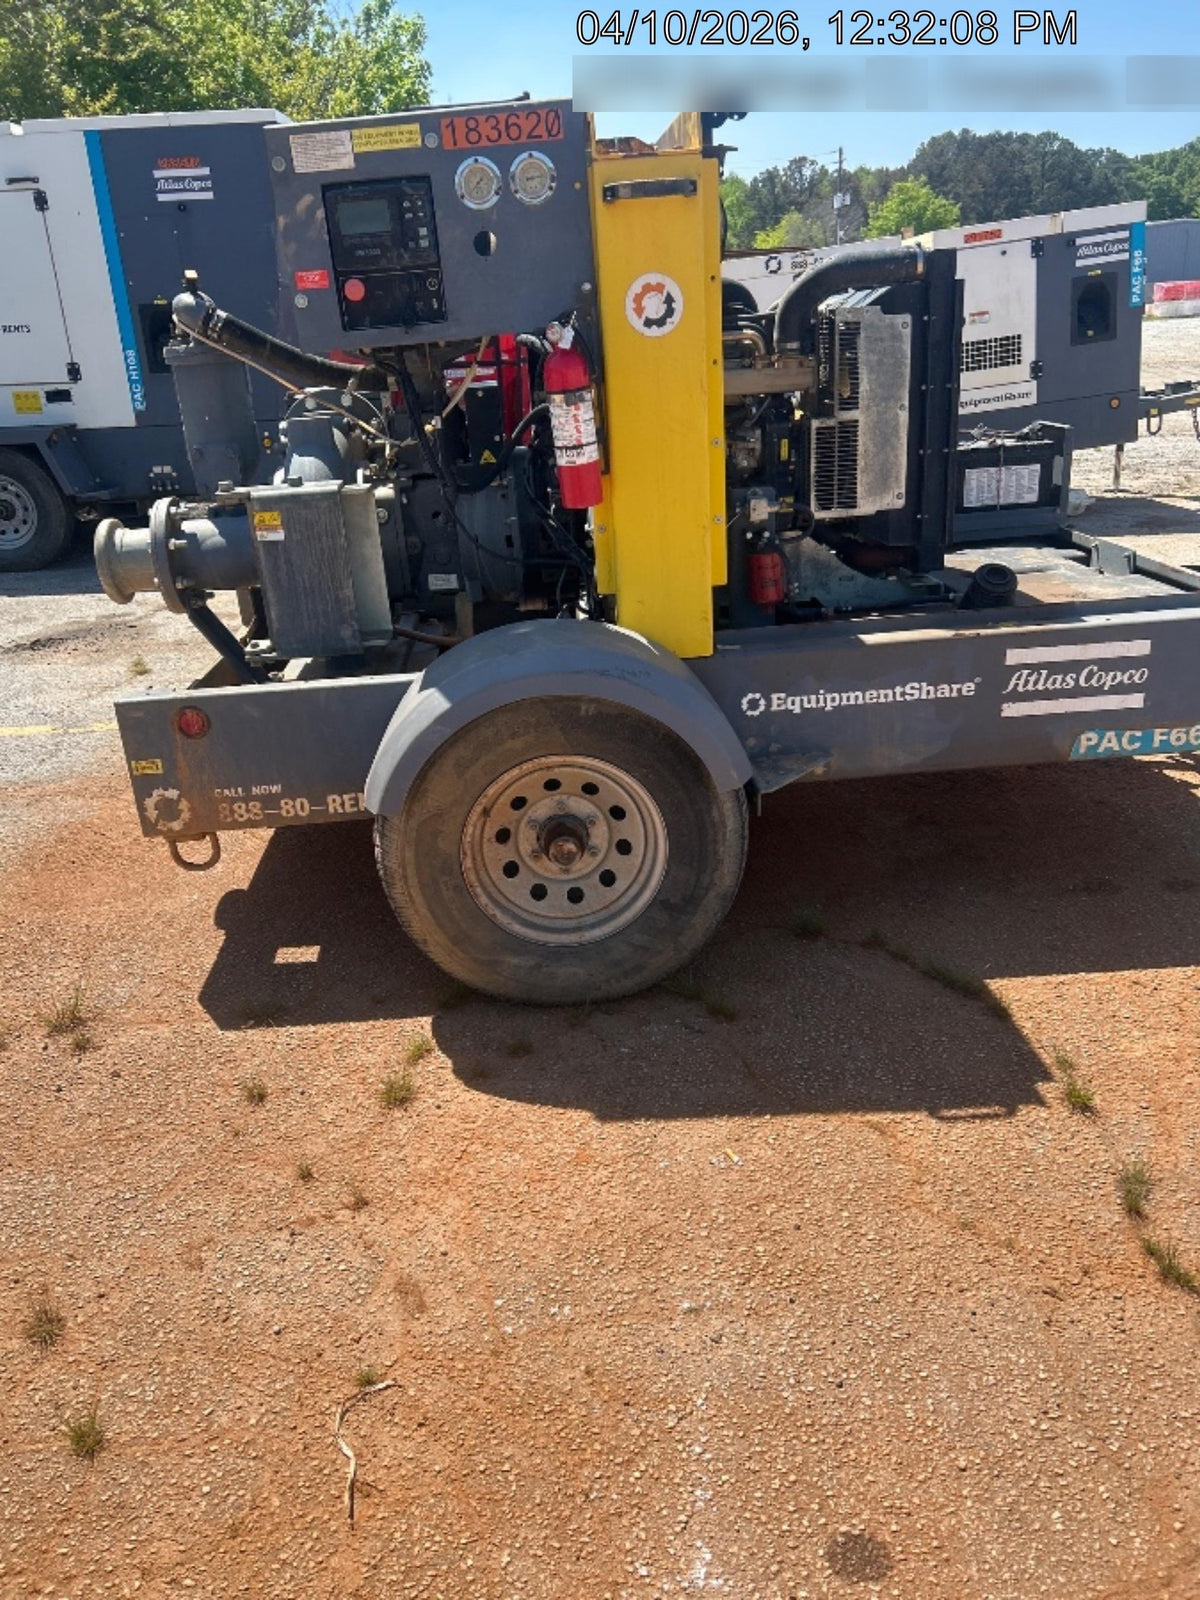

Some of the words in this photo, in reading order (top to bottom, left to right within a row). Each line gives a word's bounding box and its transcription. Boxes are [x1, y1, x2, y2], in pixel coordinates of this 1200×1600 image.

[445, 108, 561, 147] 183620
[127, 350, 139, 379] H108
[133, 384, 146, 411] PAC
[960, 391, 1031, 409] quipmentShare
[1002, 669, 1076, 694] Atlas
[1078, 664, 1149, 690] Copco
[1079, 730, 1142, 754] PAC
[215, 787, 245, 798] CALL
[252, 784, 282, 796] NOW
